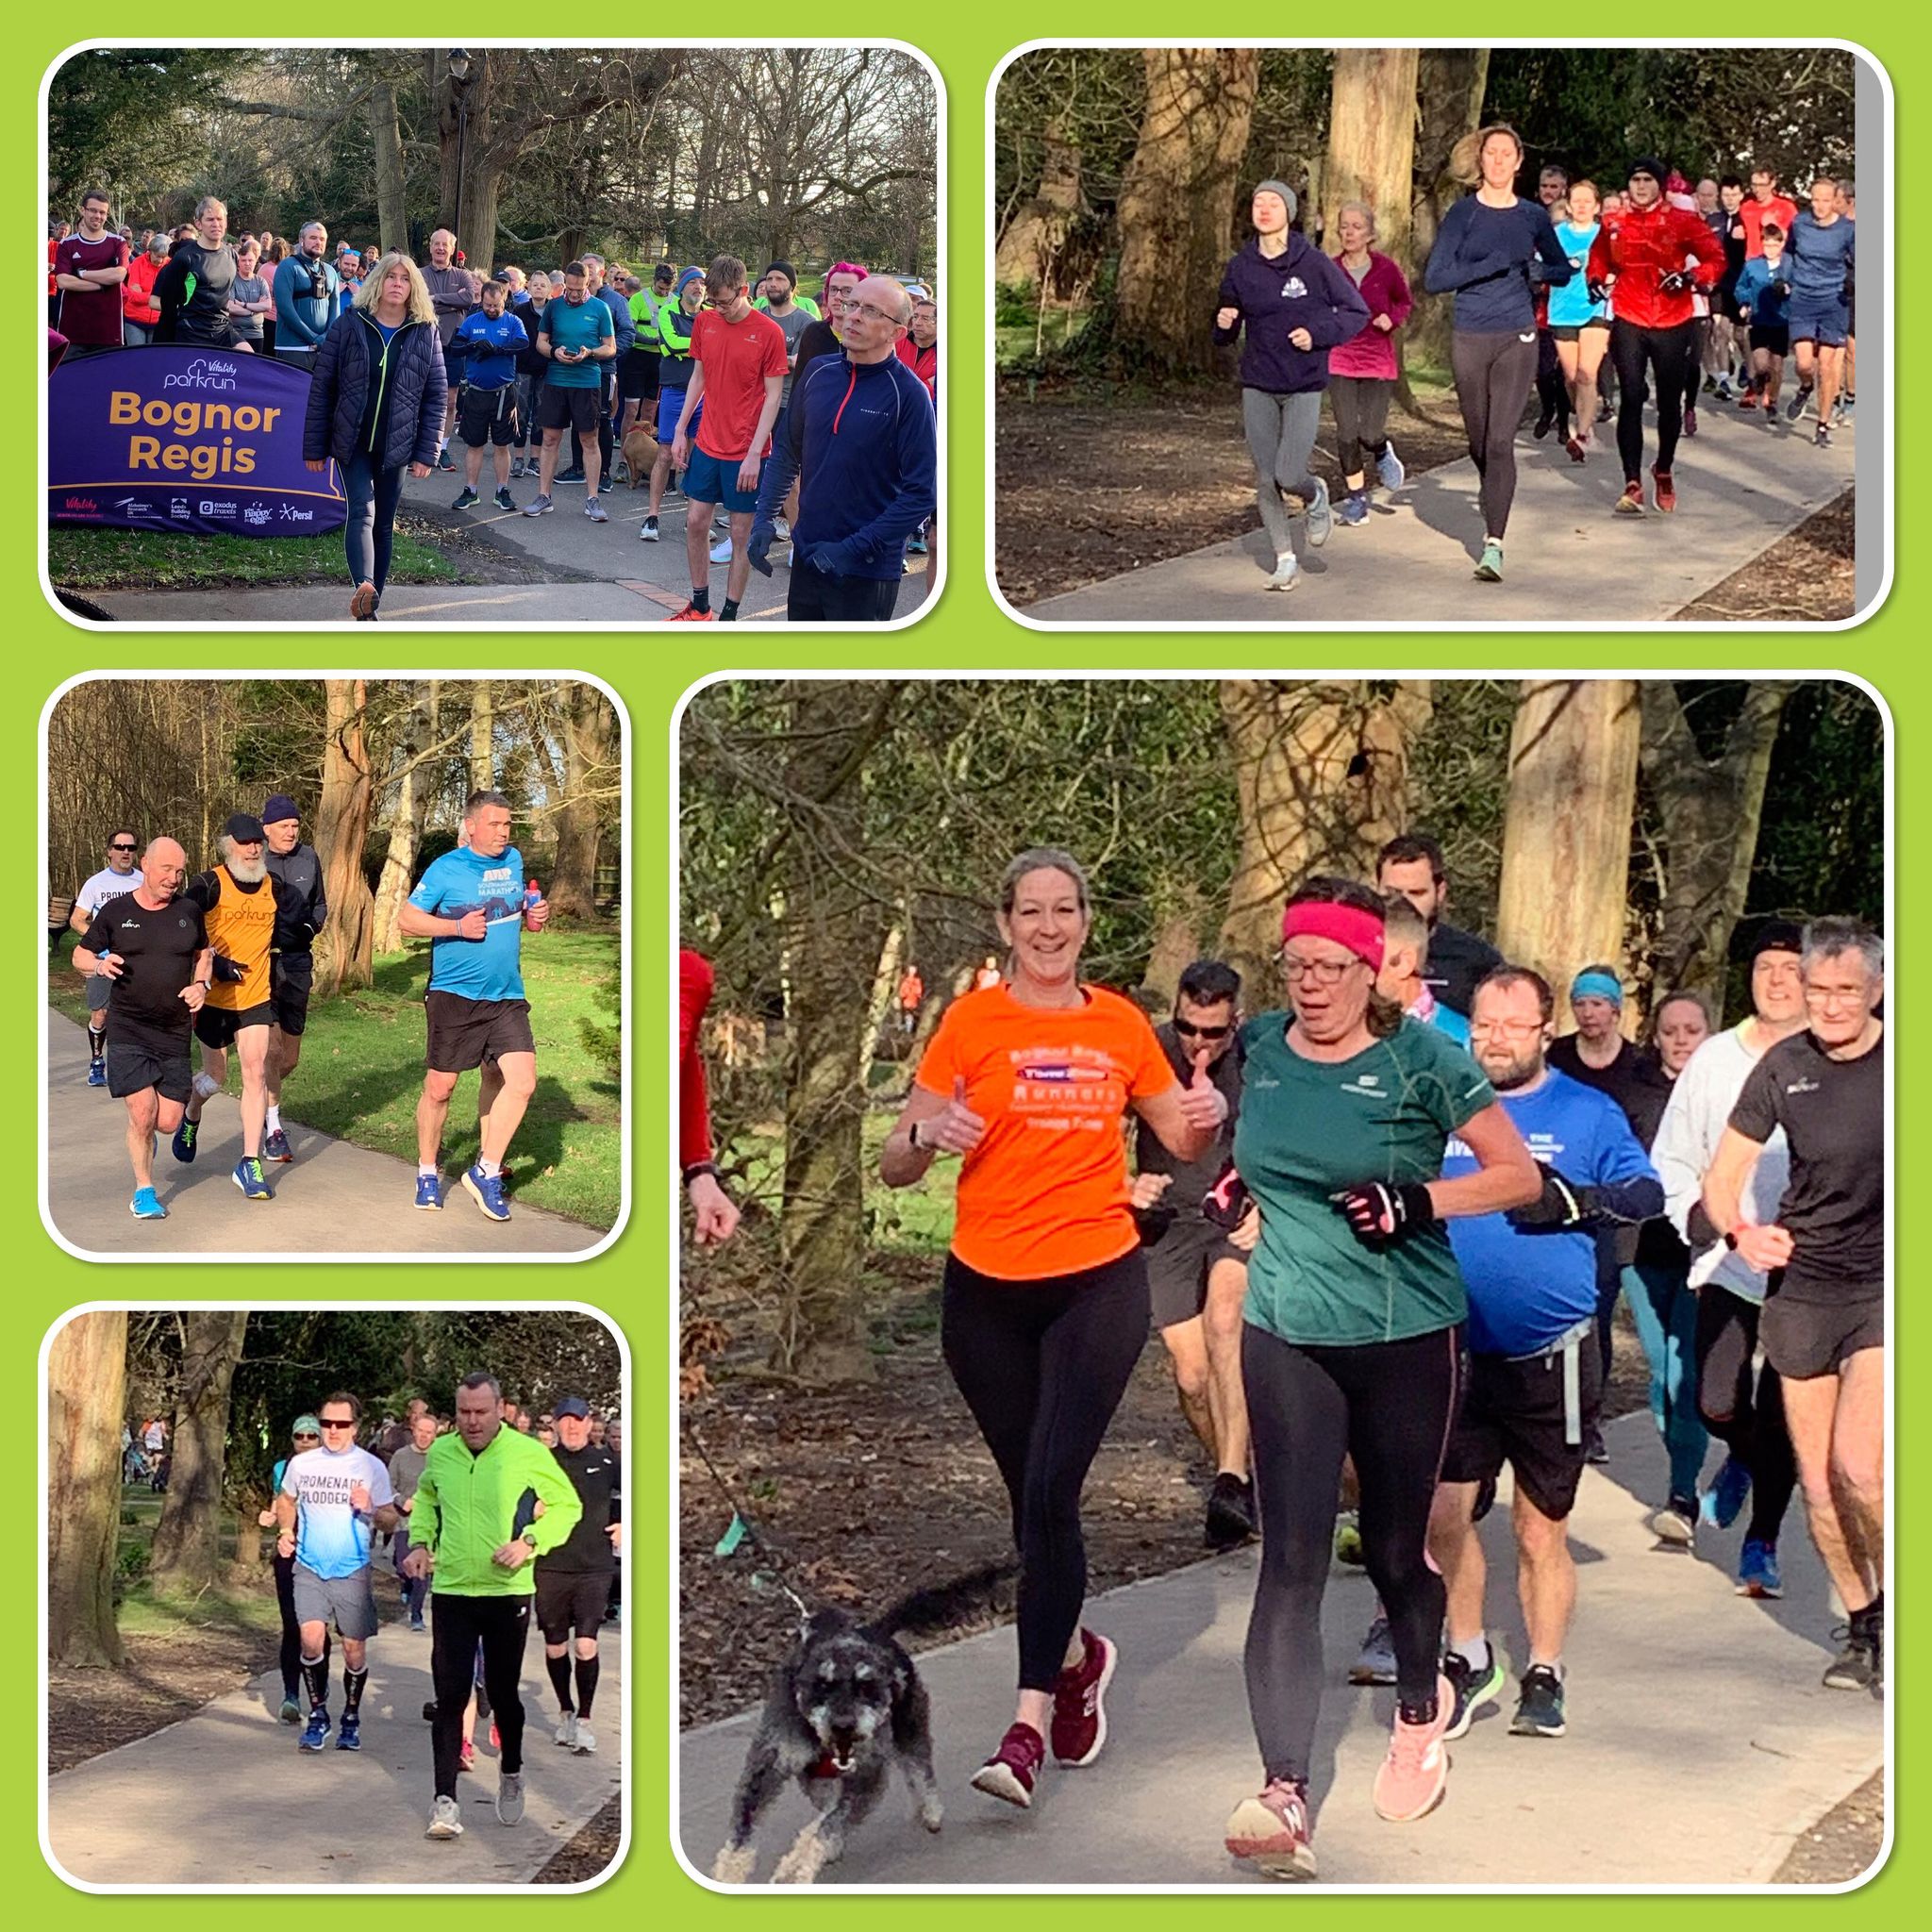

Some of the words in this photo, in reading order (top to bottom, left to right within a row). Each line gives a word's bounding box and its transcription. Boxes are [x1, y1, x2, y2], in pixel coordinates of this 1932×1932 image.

[164, 359, 236, 390] parkrun
[208, 360, 237, 376] Vitality
[109, 391, 280, 436] Bognor
[128, 436, 256, 480] Regis
[66, 497, 97, 512] Vitality
[244, 509, 273, 519] happy
[292, 510, 313, 521] Persil
[478, 888, 521, 896] MARATHON
[225, 898, 272, 921] parkrun
[299, 1475, 364, 1490] PROMENADE
